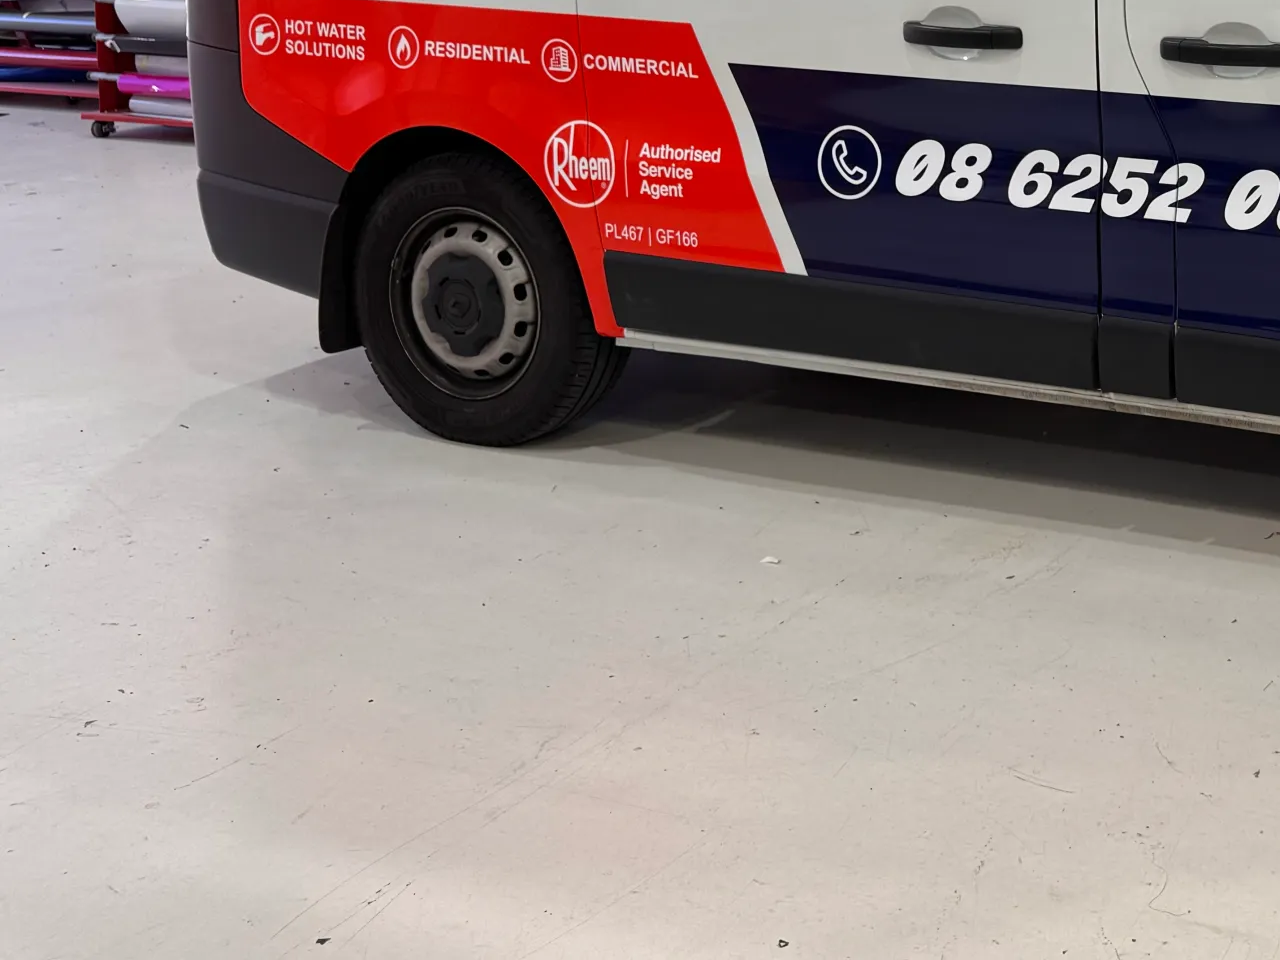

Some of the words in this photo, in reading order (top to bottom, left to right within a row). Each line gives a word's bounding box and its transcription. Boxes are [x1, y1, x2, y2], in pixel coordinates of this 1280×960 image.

[285, 19, 313, 36] HOT
[316, 23, 366, 41] WATER
[285, 39, 366, 61] SOLUTIONS
[424, 40, 531, 65] RESIDENTIAL
[583, 53, 699, 79] COMMERCIAL
[552, 123, 612, 191] Rheem
[638, 142, 722, 164] Authorised
[638, 161, 694, 180] Service
[895, 139, 993, 202] 08
[1007, 149, 1204, 223] 6252
[639, 179, 684, 200] Agent
[604, 222, 644, 242] PL467
[655, 228, 698, 248] GF166
